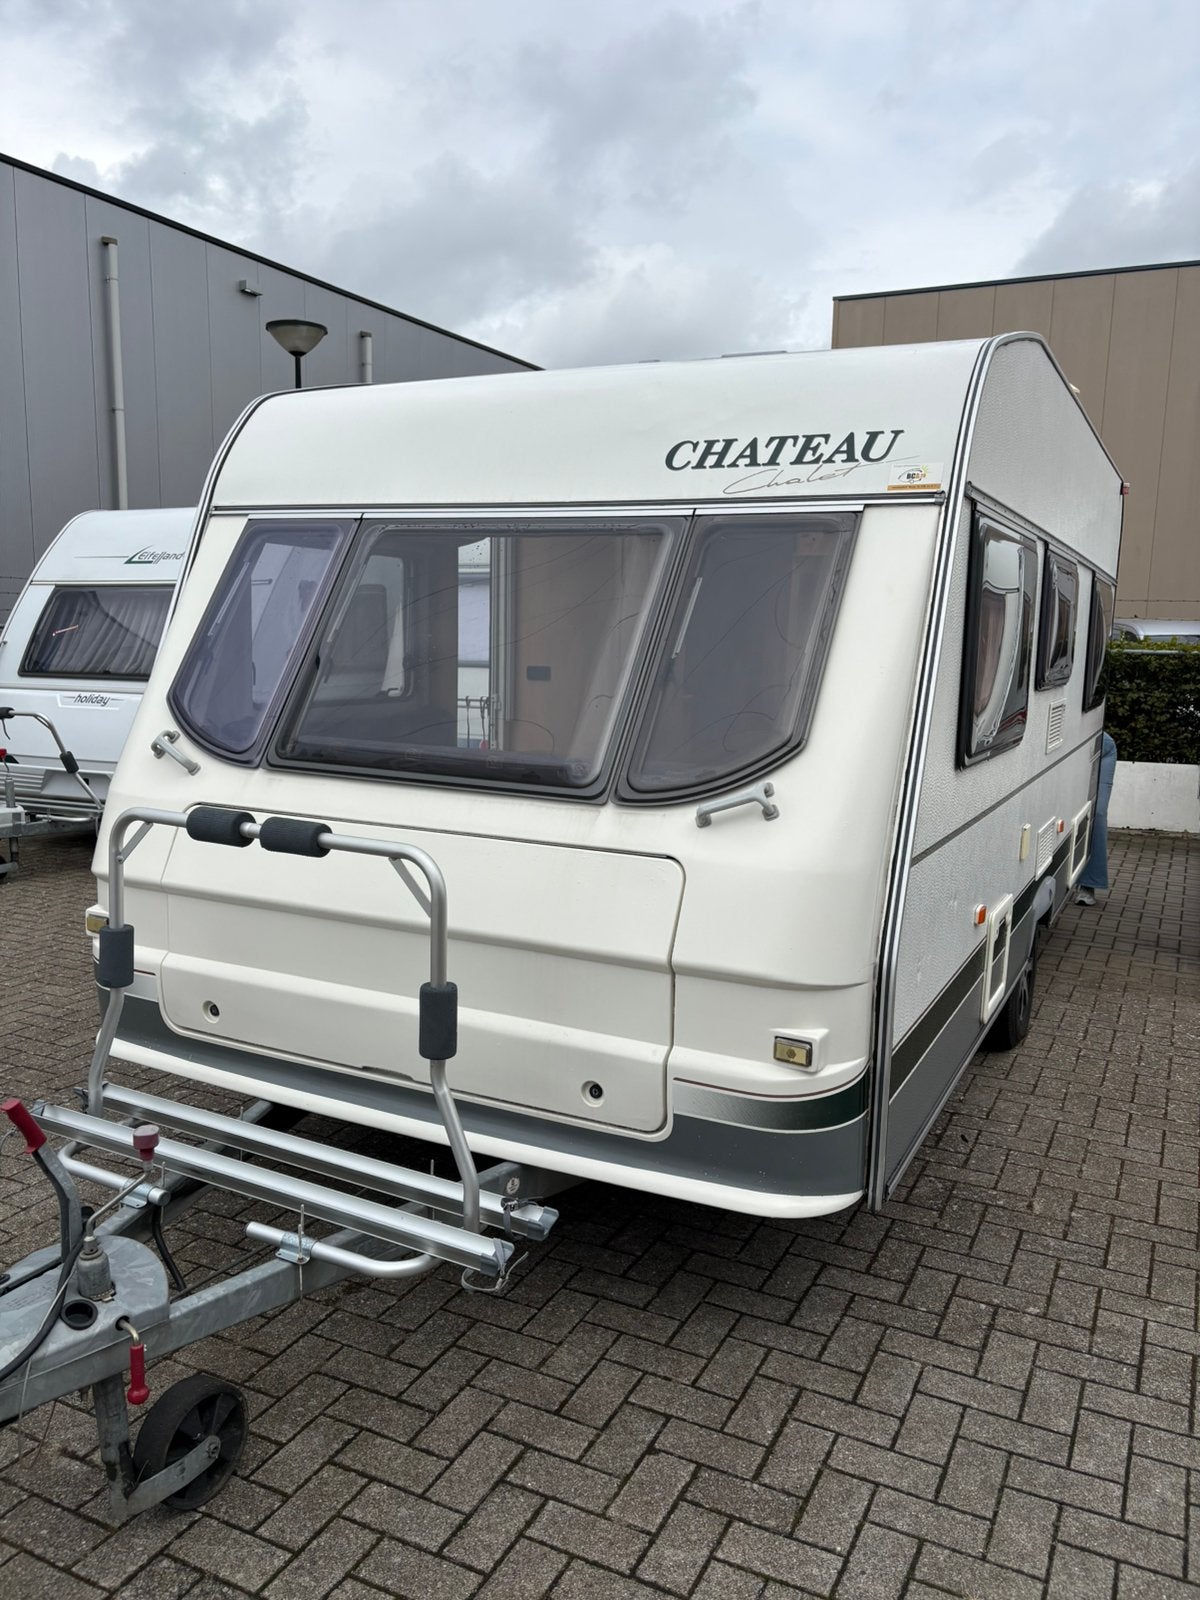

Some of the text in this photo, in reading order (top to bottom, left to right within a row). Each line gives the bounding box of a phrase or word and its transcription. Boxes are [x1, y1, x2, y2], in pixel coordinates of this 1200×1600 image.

[665, 430, 904, 471] CHATEAU
[723, 462, 880, 495] Chalet
[138, 551, 185, 564] Eifelland
[74, 693, 110, 707] holiday
